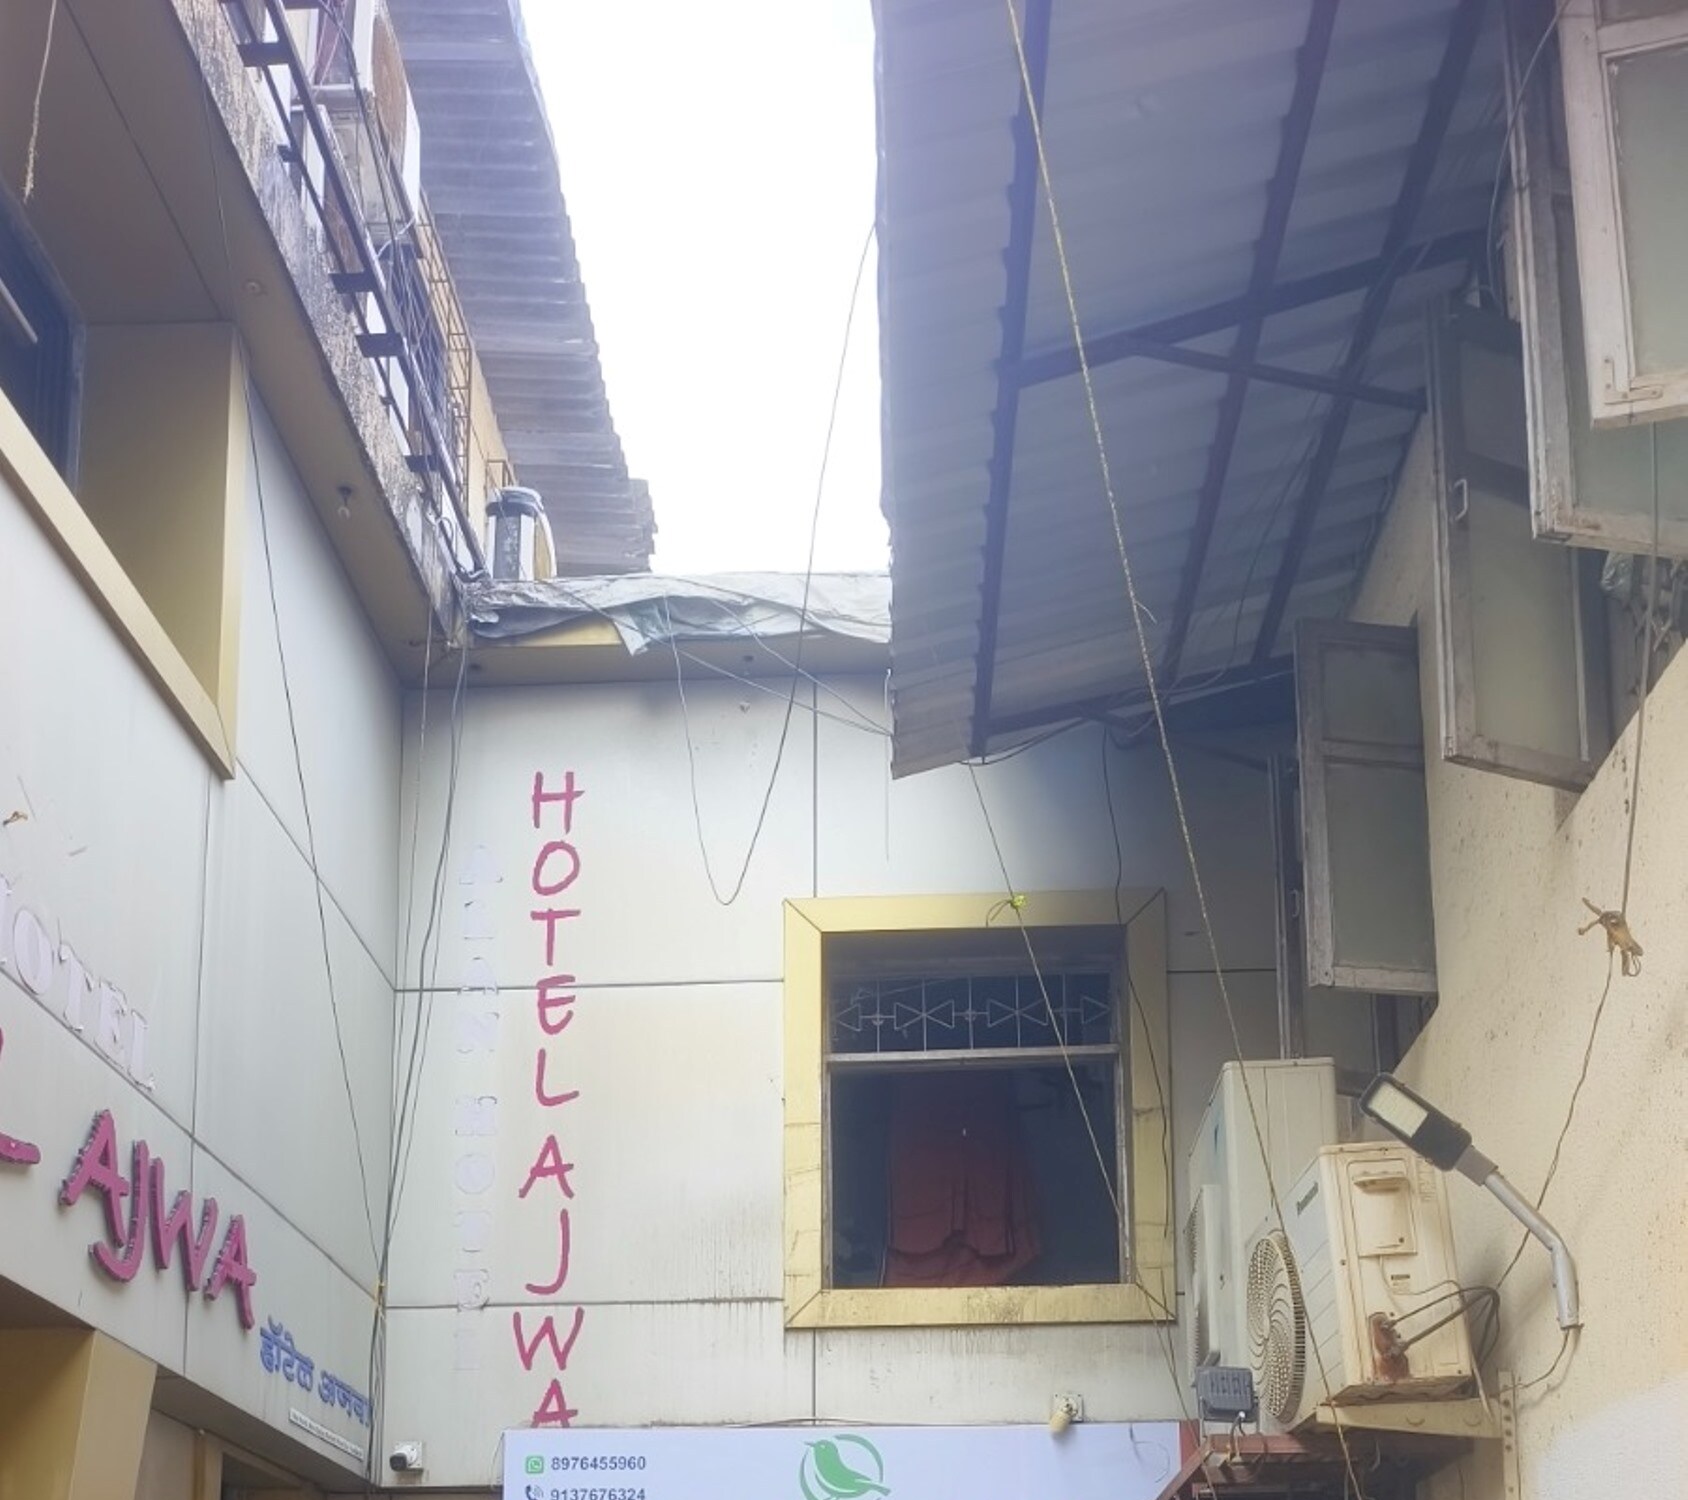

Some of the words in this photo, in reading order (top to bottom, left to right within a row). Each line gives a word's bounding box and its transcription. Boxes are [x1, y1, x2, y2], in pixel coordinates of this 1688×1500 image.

[529, 771, 585, 1107] HOTEL
[58, 1108, 258, 1330] AJWA
[512, 1133, 584, 1429] AJWA
[551, 1455, 647, 1471] 8976455960
